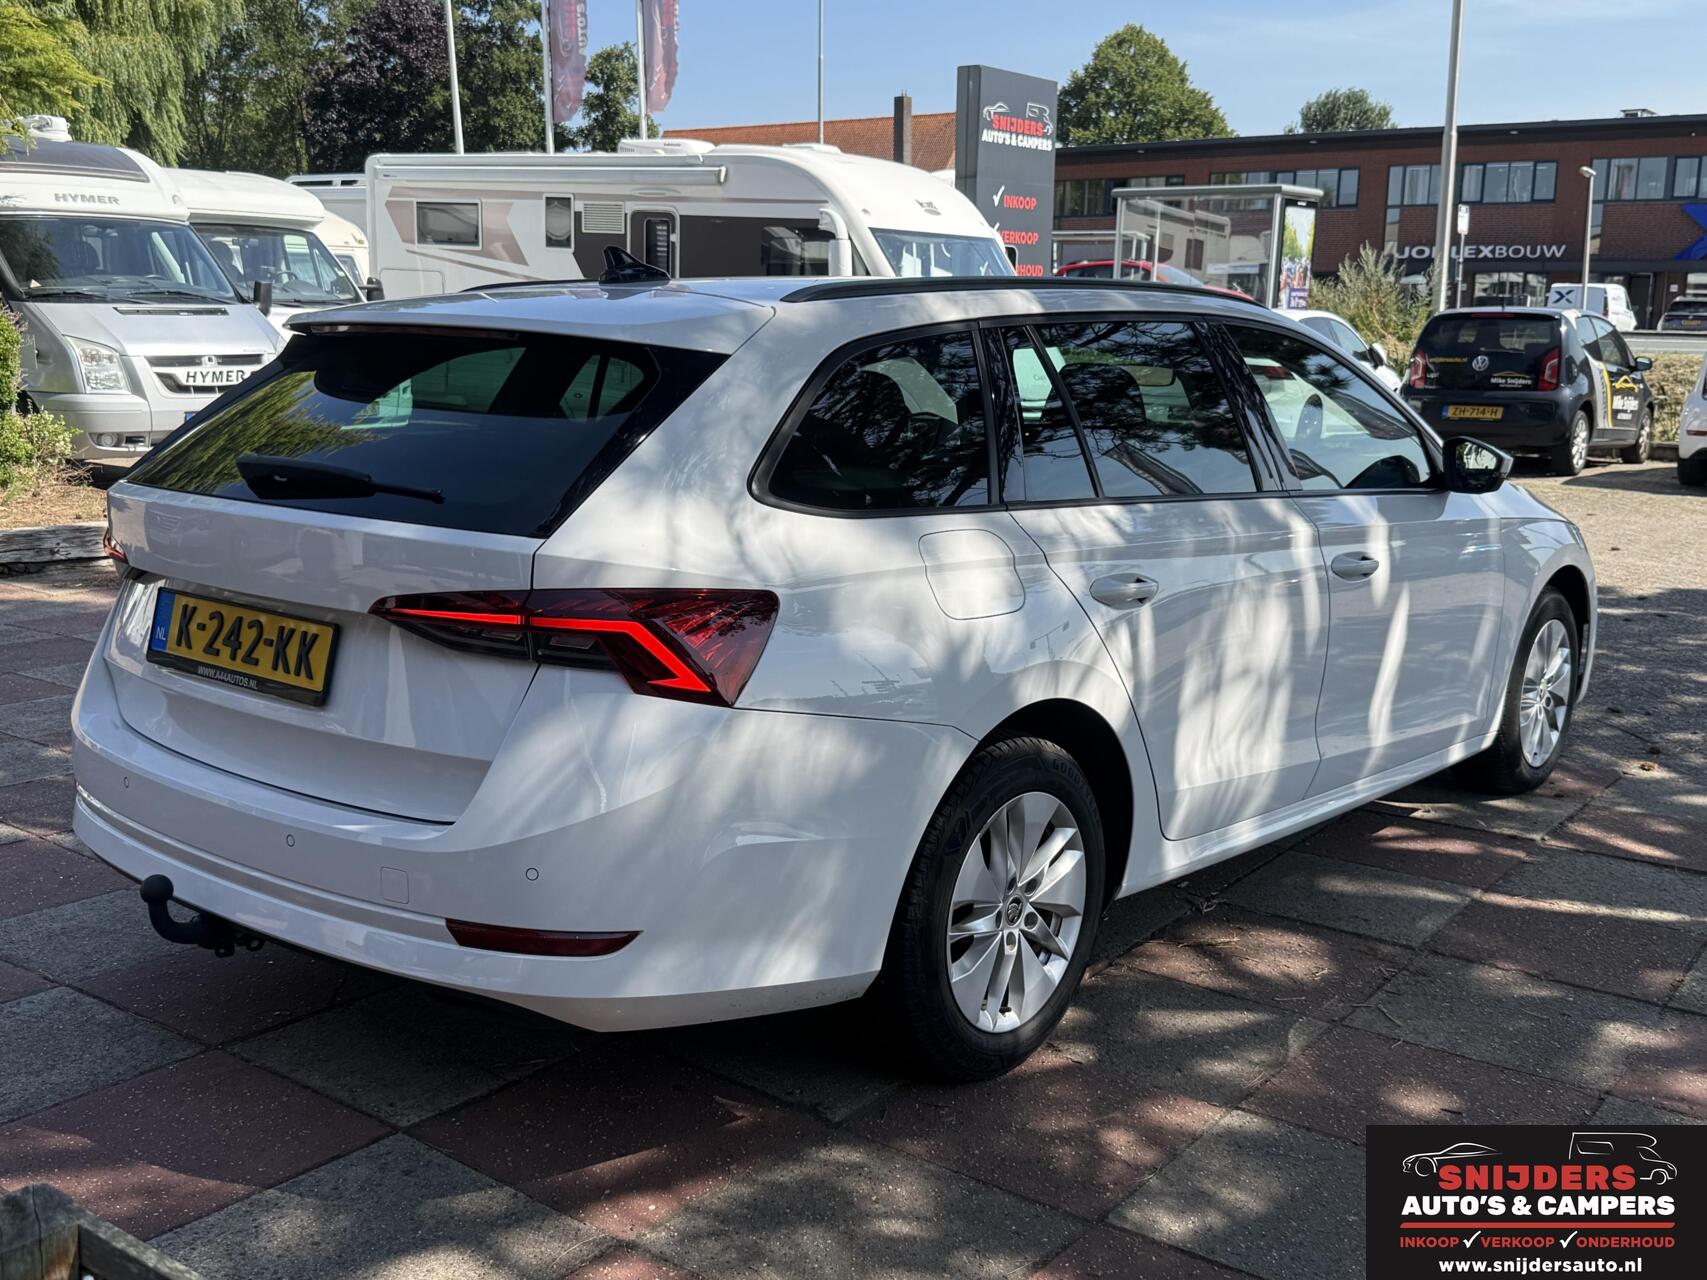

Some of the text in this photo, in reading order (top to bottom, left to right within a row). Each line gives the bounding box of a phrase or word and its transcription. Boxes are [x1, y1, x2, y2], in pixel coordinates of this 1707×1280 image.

[992, 113, 1044, 137] SNIJDERS
[981, 128, 1052, 152] AUTO'S & CAMPERS
[54, 192, 121, 205] HYMER
[1003, 195, 1037, 210] INKOOP
[185, 370, 246, 384] HYMER
[155, 629, 167, 641] NL
[175, 603, 319, 681] K-242-KK
